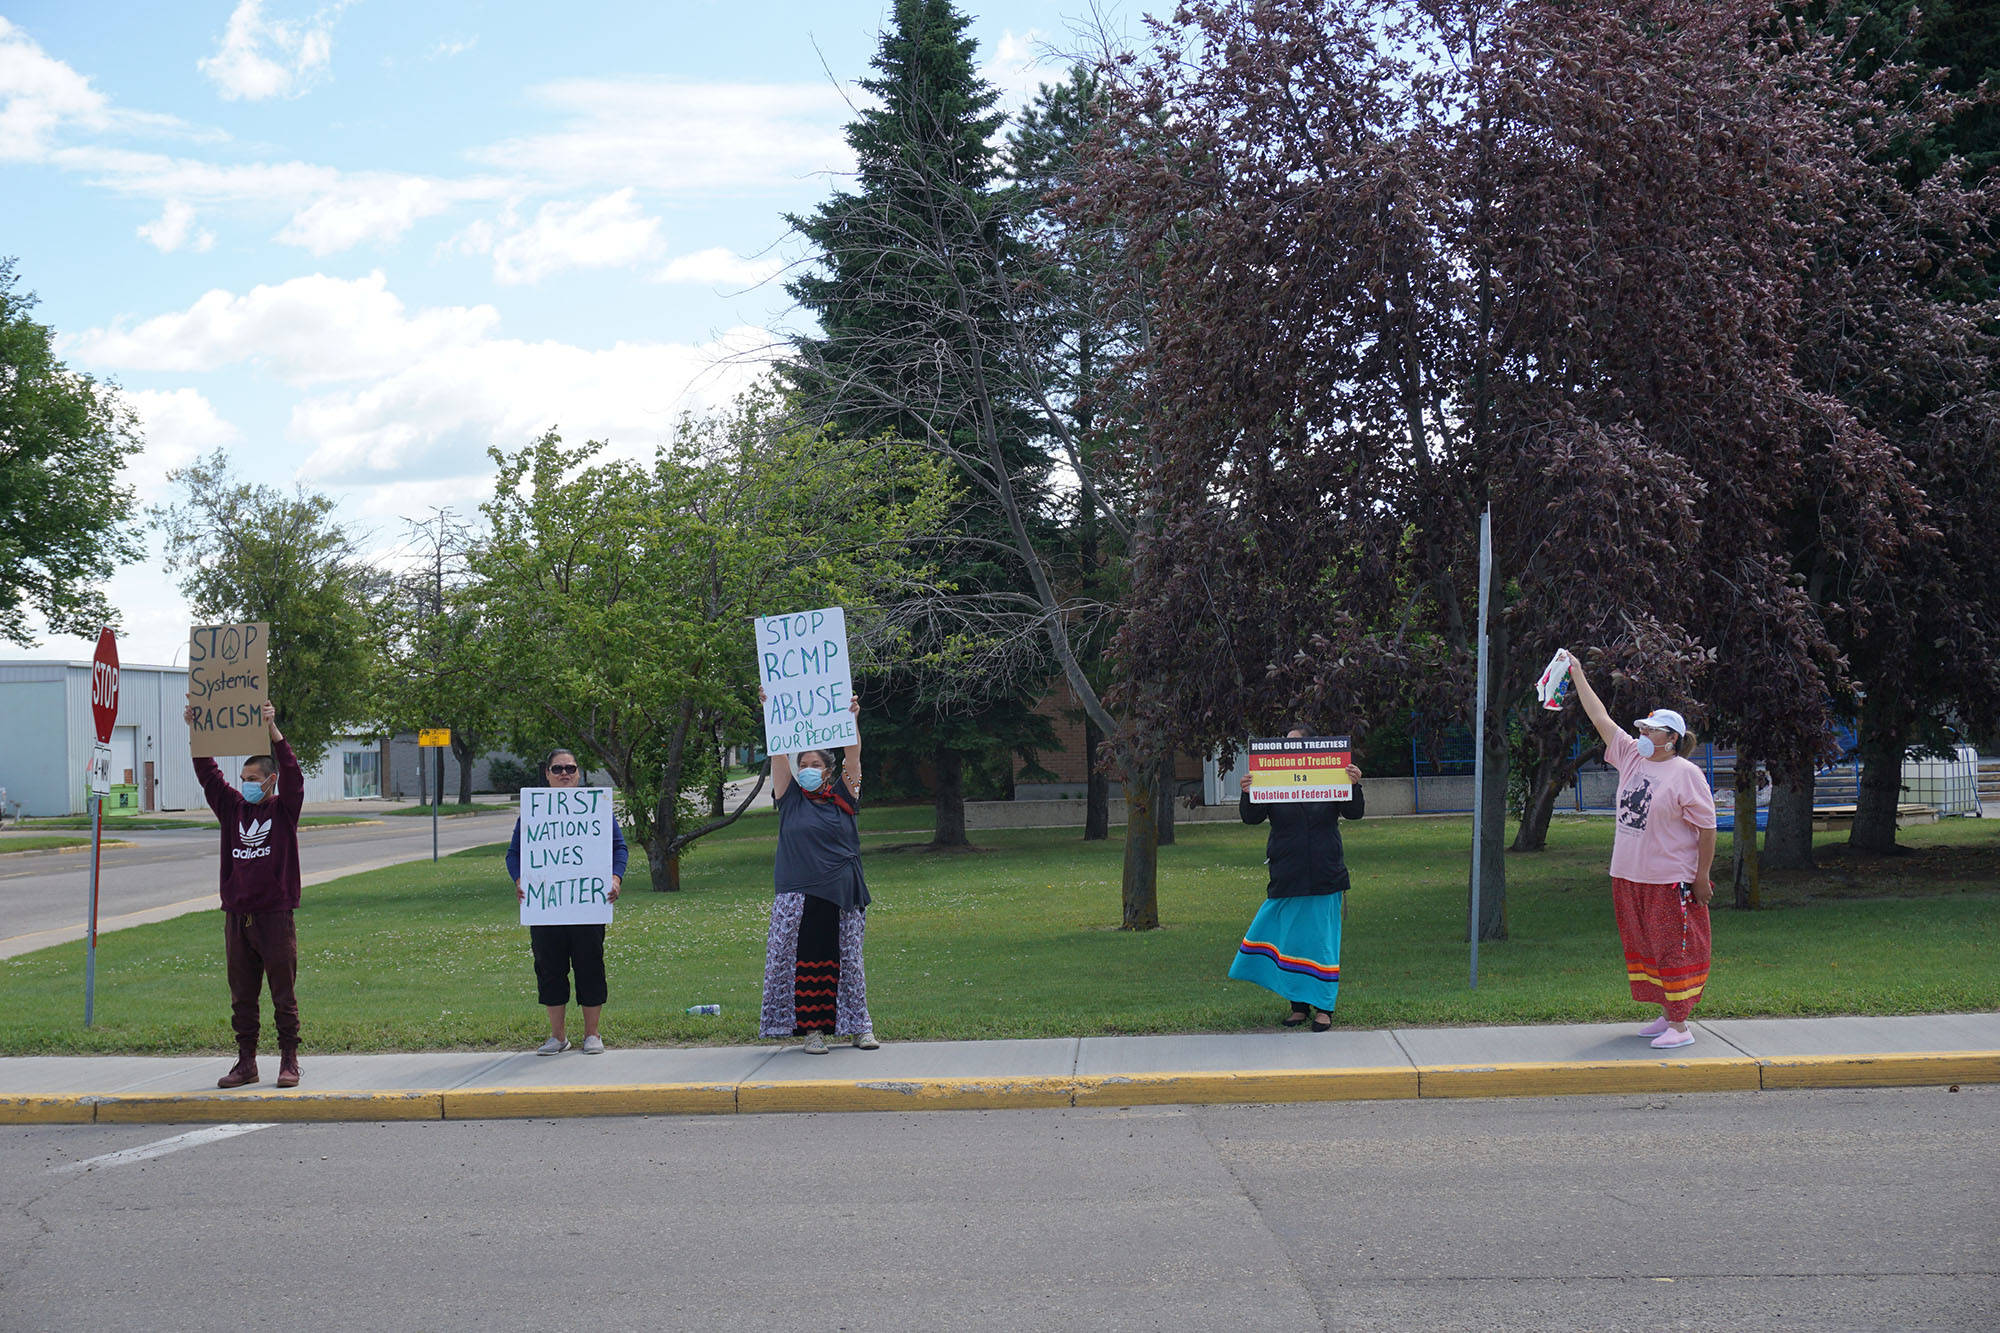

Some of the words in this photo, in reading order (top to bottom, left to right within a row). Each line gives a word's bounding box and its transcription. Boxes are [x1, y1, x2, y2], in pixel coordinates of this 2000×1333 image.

[766, 612, 824, 645] STOP
[190, 626, 257, 661] STOP
[764, 640, 838, 682] RCMP
[92, 660, 119, 710] STOP
[192, 667, 259, 701] Systemic
[770, 681, 848, 725] ABUSE
[192, 704, 261, 732] RACISM
[794, 719, 813, 733] ON
[770, 733, 802, 752] OUR
[806, 721, 855, 746] PEOPLE
[1251, 742, 1282, 751] HONOR
[1284, 741, 1302, 750] OUR
[1304, 740, 1348, 749] TREATIES!
[1258, 757, 1296, 768] Violation
[1297, 756, 1306, 767] of
[1307, 755, 1342, 766] Treaties
[1302, 774, 1307, 782] a
[531, 789, 604, 817] FIRST
[1252, 790, 1290, 800] Violation
[1291, 790, 1300, 800] of
[1301, 789, 1331, 799] Federal
[1333, 788, 1349, 799] Law
[527, 820, 601, 843] NATIONS
[232, 846, 271, 860] adidas
[530, 845, 583, 869] LIVES
[526, 877, 608, 910] MATTER
